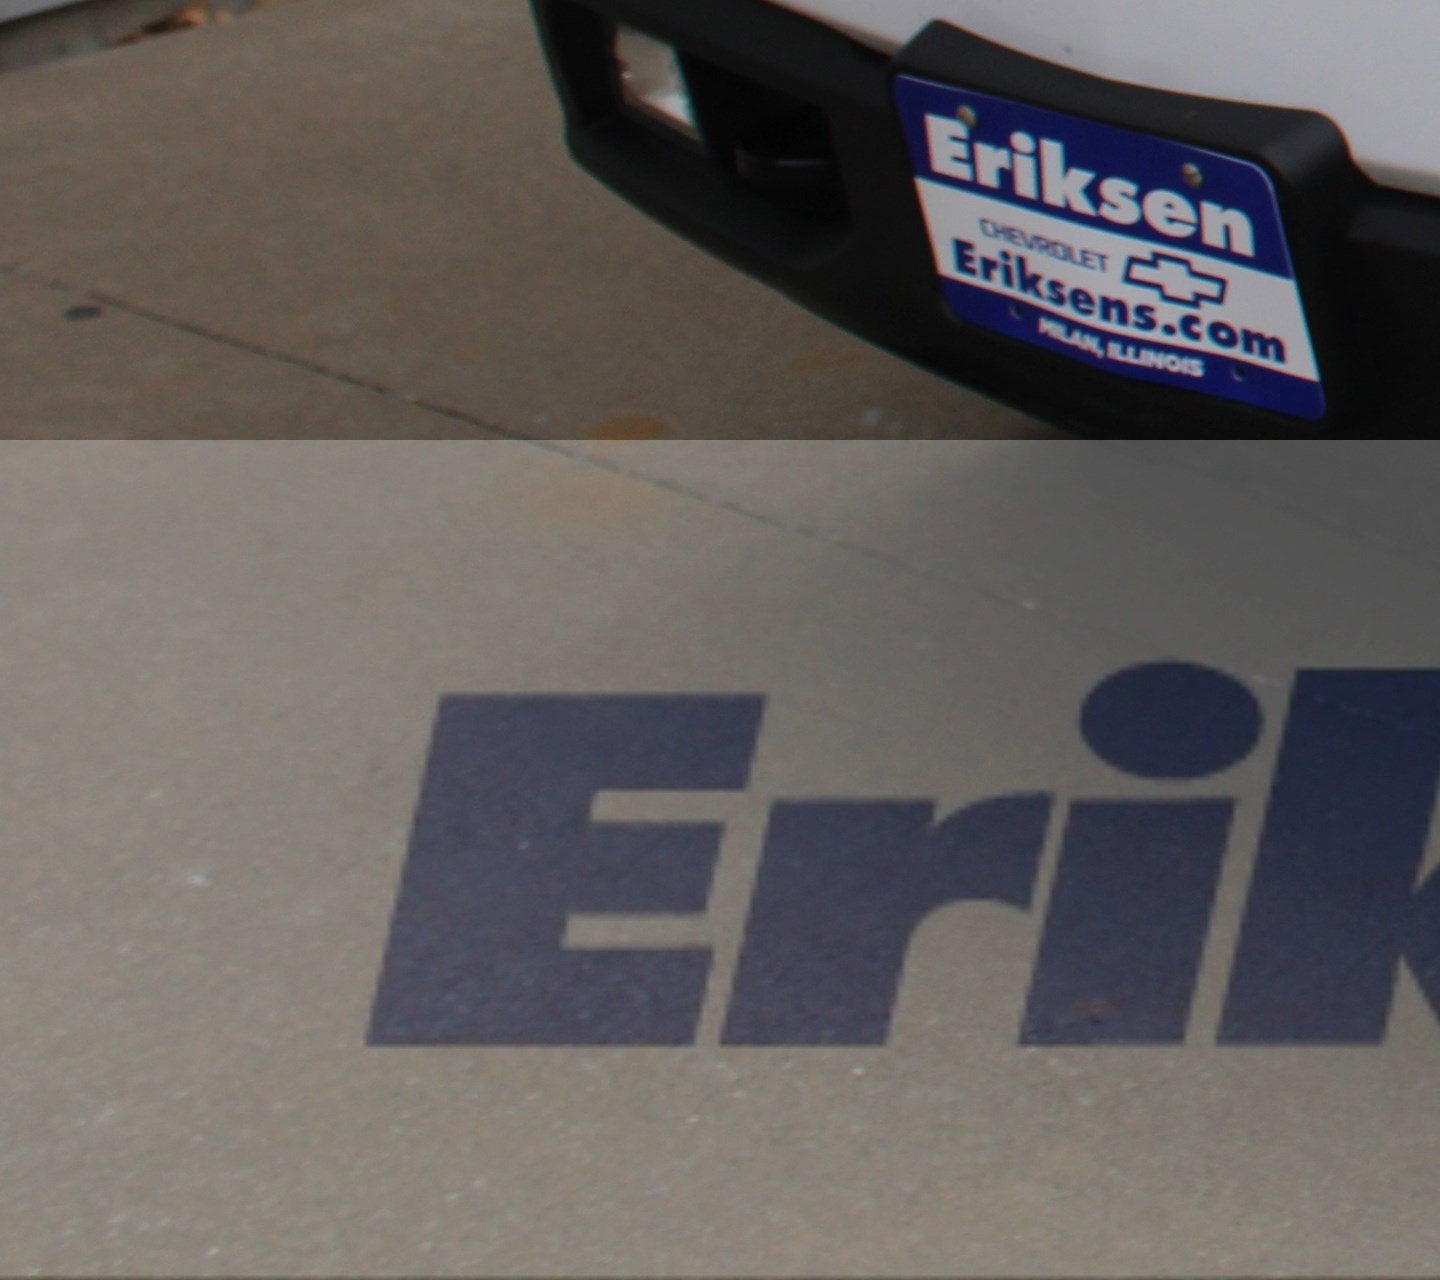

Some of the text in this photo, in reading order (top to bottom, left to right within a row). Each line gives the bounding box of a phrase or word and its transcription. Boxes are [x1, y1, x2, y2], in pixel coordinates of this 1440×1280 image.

[924, 113, 1255, 258] Eriksen
[979, 218, 1109, 273] CHEVROLET
[951, 238, 1286, 365] Eriksens.com
[1038, 317, 1205, 378] MILAN, ILLINOIS
